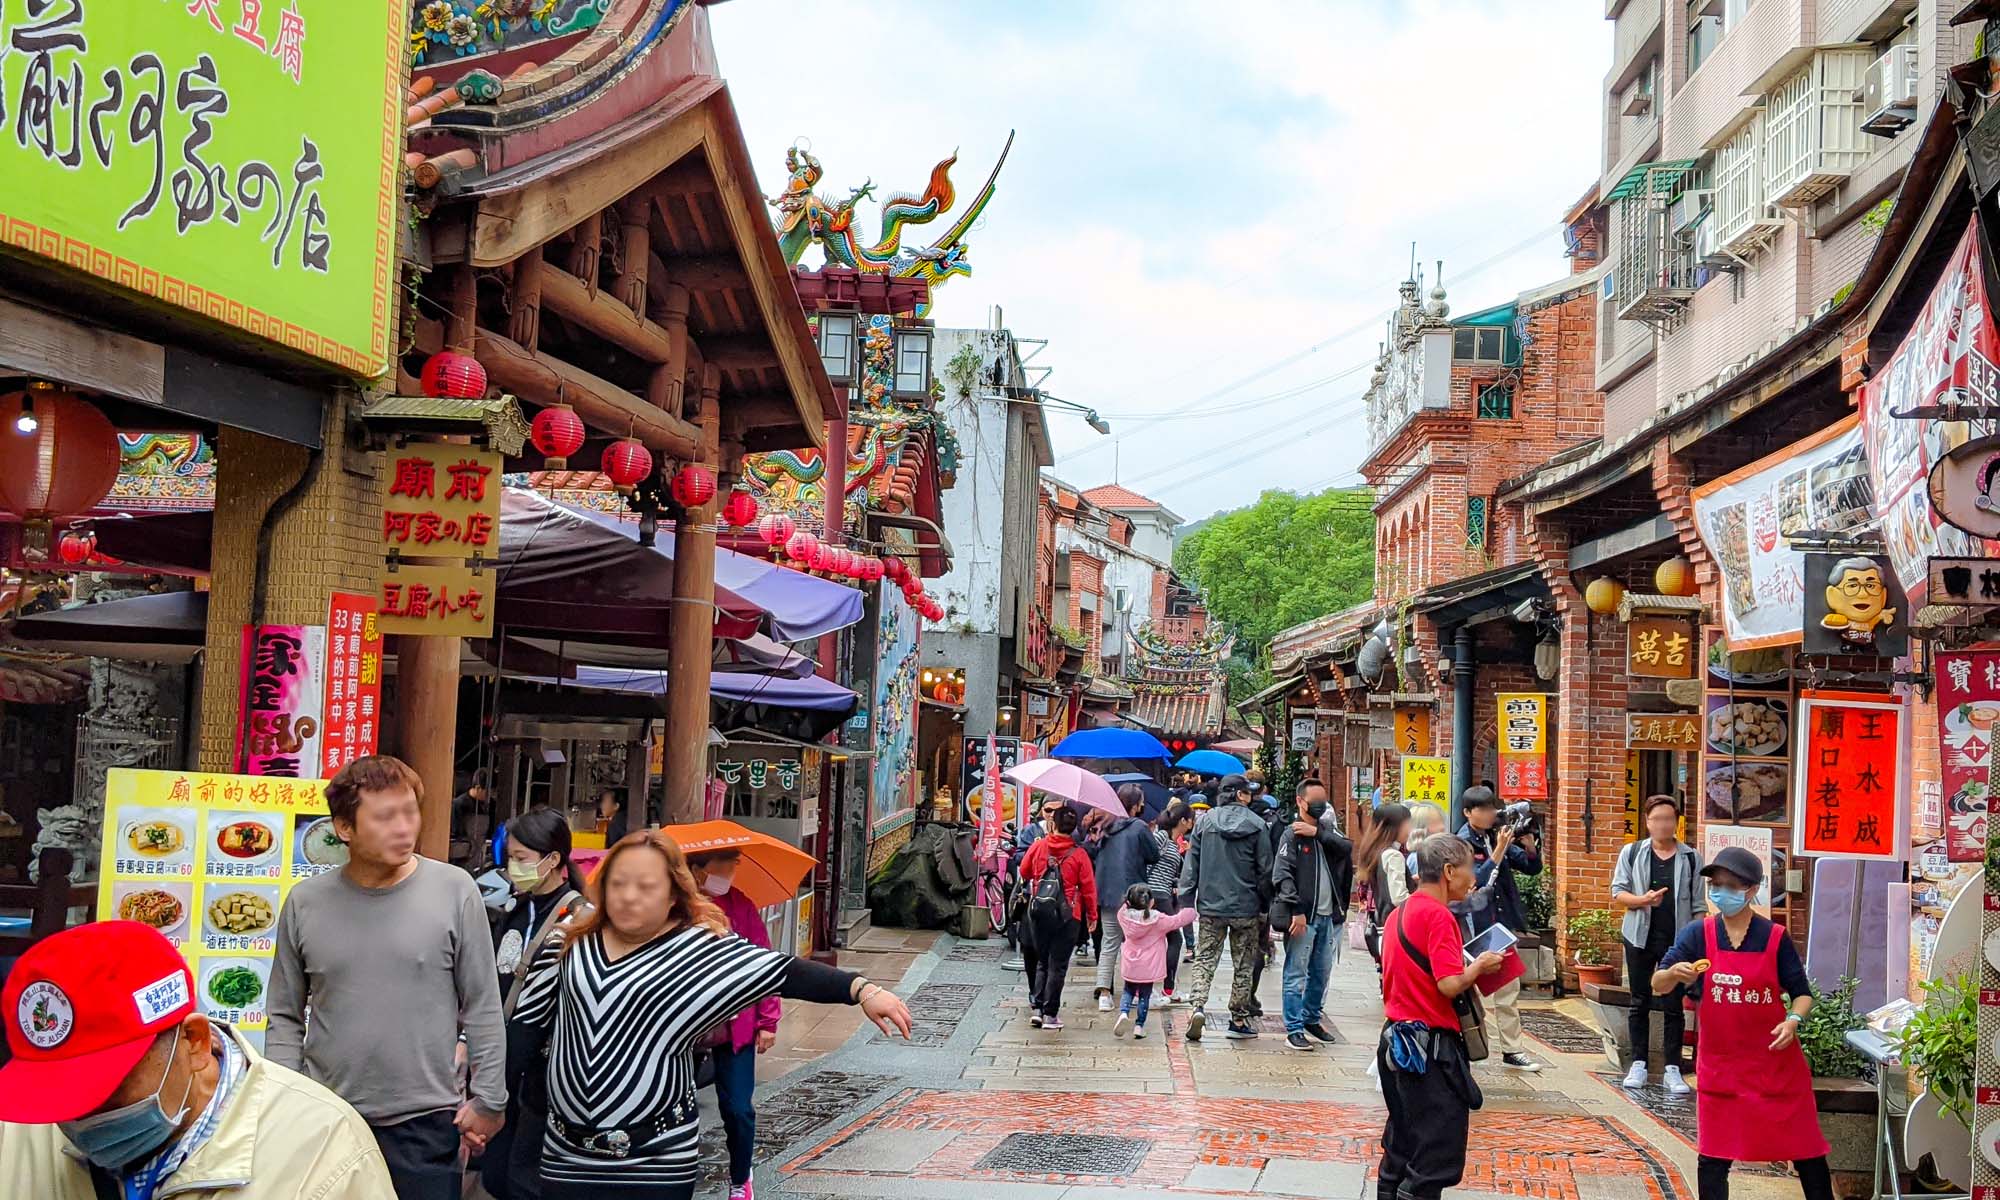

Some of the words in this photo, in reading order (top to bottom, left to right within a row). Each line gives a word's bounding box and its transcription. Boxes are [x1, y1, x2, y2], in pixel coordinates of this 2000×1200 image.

[0, 0, 330, 271] 前阿家の店
[389, 456, 492, 502] 廟前
[384, 511, 492, 545] 阿家の店
[379, 583, 485, 622] 豆腐小吃
[1632, 629, 1690, 667] 萬吉
[1631, 719, 1699, 745] 豆腐美食
[716, 759, 801, 791] 七里香
[1418, 775, 1435, 789] 炸
[1813, 708, 1845, 842] 廟口老店
[1855, 713, 1885, 846] 王水成
[167, 776, 321, 806] 廟前的好滋味
[180, 863, 192, 875] 60
[269, 865, 281, 878] 60
[253, 938, 271, 950] 120
[22, 1018, 36, 1039] TOUR
[37, 1035, 46, 1044] OF
[243, 1011, 262, 1023] 100
